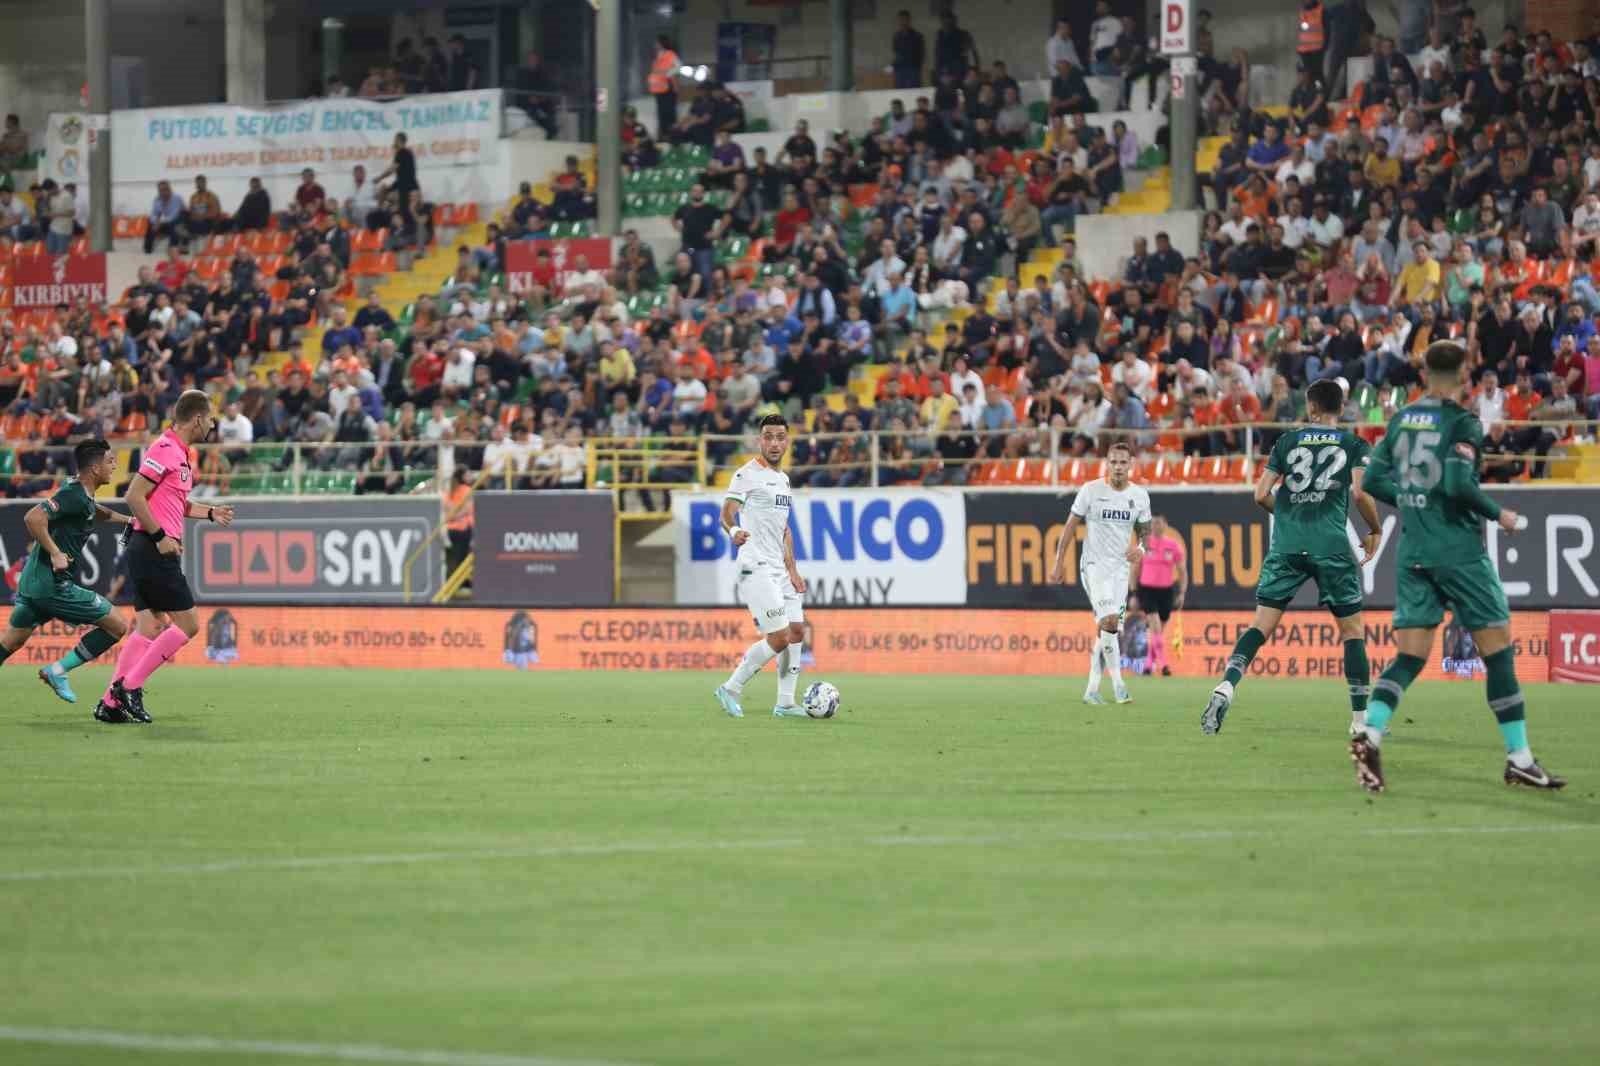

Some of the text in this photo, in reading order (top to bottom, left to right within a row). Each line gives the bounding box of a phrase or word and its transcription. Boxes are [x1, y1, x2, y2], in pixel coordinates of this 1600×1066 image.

[1167, 4, 1184, 33] D
[148, 115, 228, 142] FUTBOL
[321, 109, 391, 131] ENGEL
[398, 100, 489, 128] TANIMAZ
[1303, 433, 1337, 442] aksa
[1285, 445, 1347, 493] 32
[1392, 430, 1442, 490] 15
[1102, 508, 1131, 520] TAV
[323, 529, 412, 586] SAY
[251, 629, 266, 647] 16
[270, 626, 308, 647] ÜLKE
[312, 629, 338, 646] 90+
[343, 626, 404, 647] STÜDYO
[440, 625, 485, 648] ÖDÜL
[579, 621, 743, 641] CLEOPATRAINK
[828, 634, 845, 649] 16
[850, 630, 893, 650] ÜLKE
[898, 634, 927, 650] 90+
[933, 630, 1004, 651] STÜDYO
[1008, 634, 1039, 651] 80+
[580, 651, 646, 668] TATTOO
[650, 652, 661, 667] &
[1286, 657, 1299, 675] &
